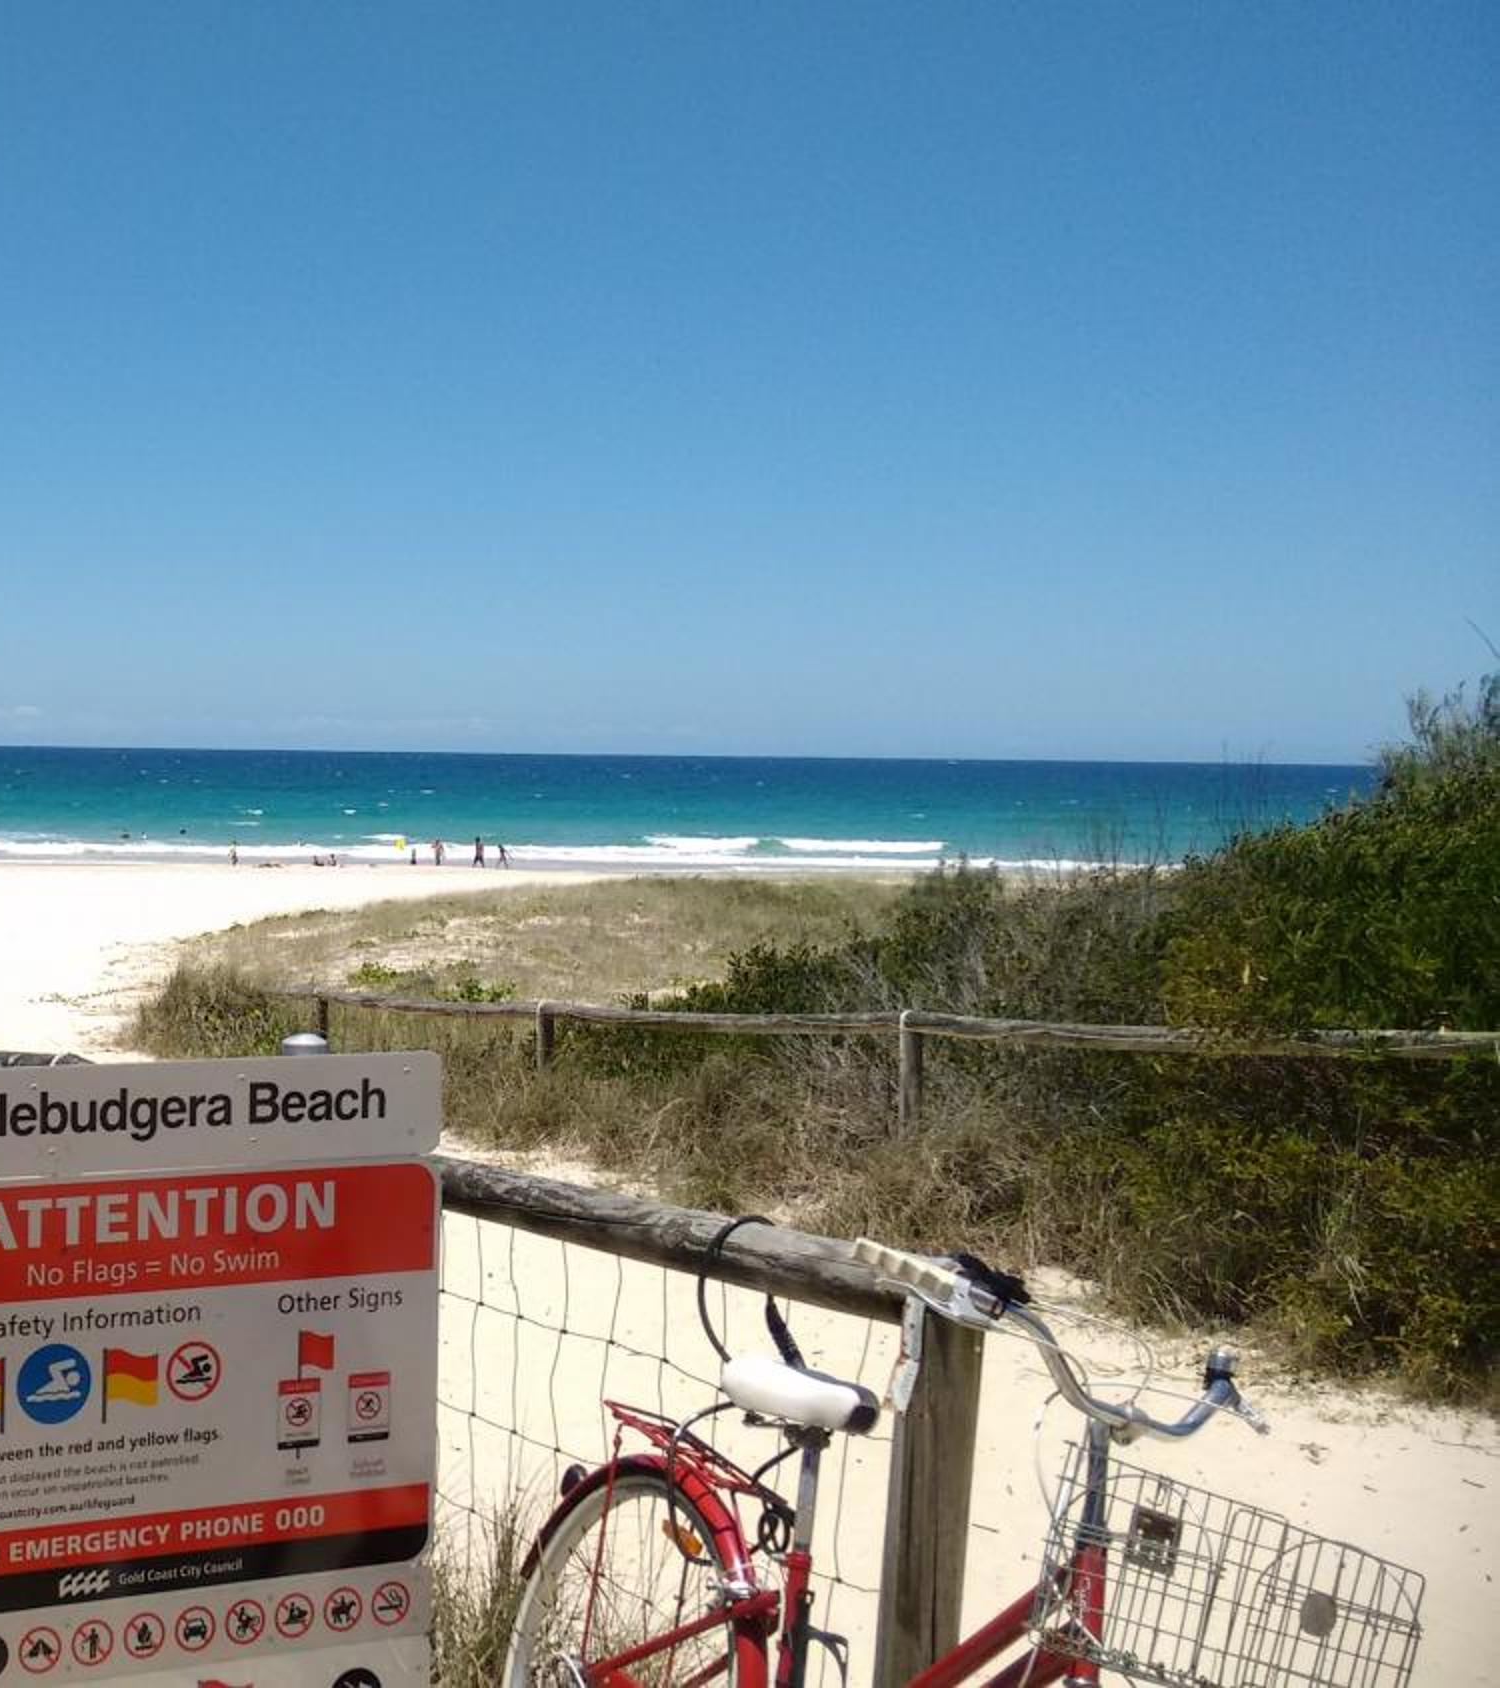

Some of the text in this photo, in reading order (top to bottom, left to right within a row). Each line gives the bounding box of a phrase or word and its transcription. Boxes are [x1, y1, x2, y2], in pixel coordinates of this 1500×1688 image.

[248, 1078, 387, 1125] Beach
[26, 1249, 279, 1287] No Flags = No Swim
[277, 1287, 404, 1315] Other Signs
[62, 1304, 202, 1332] Information
[38, 1442, 63, 1457] the
[68, 1439, 93, 1455] red
[97, 1435, 125, 1451] and
[129, 1431, 179, 1452] yellow
[63, 1464, 81, 1477] the
[84, 1461, 116, 1475] beach
[8, 1505, 325, 1562] EMERGENCY PHONE 000
[118, 1558, 243, 1585] Gold Coast City Council
